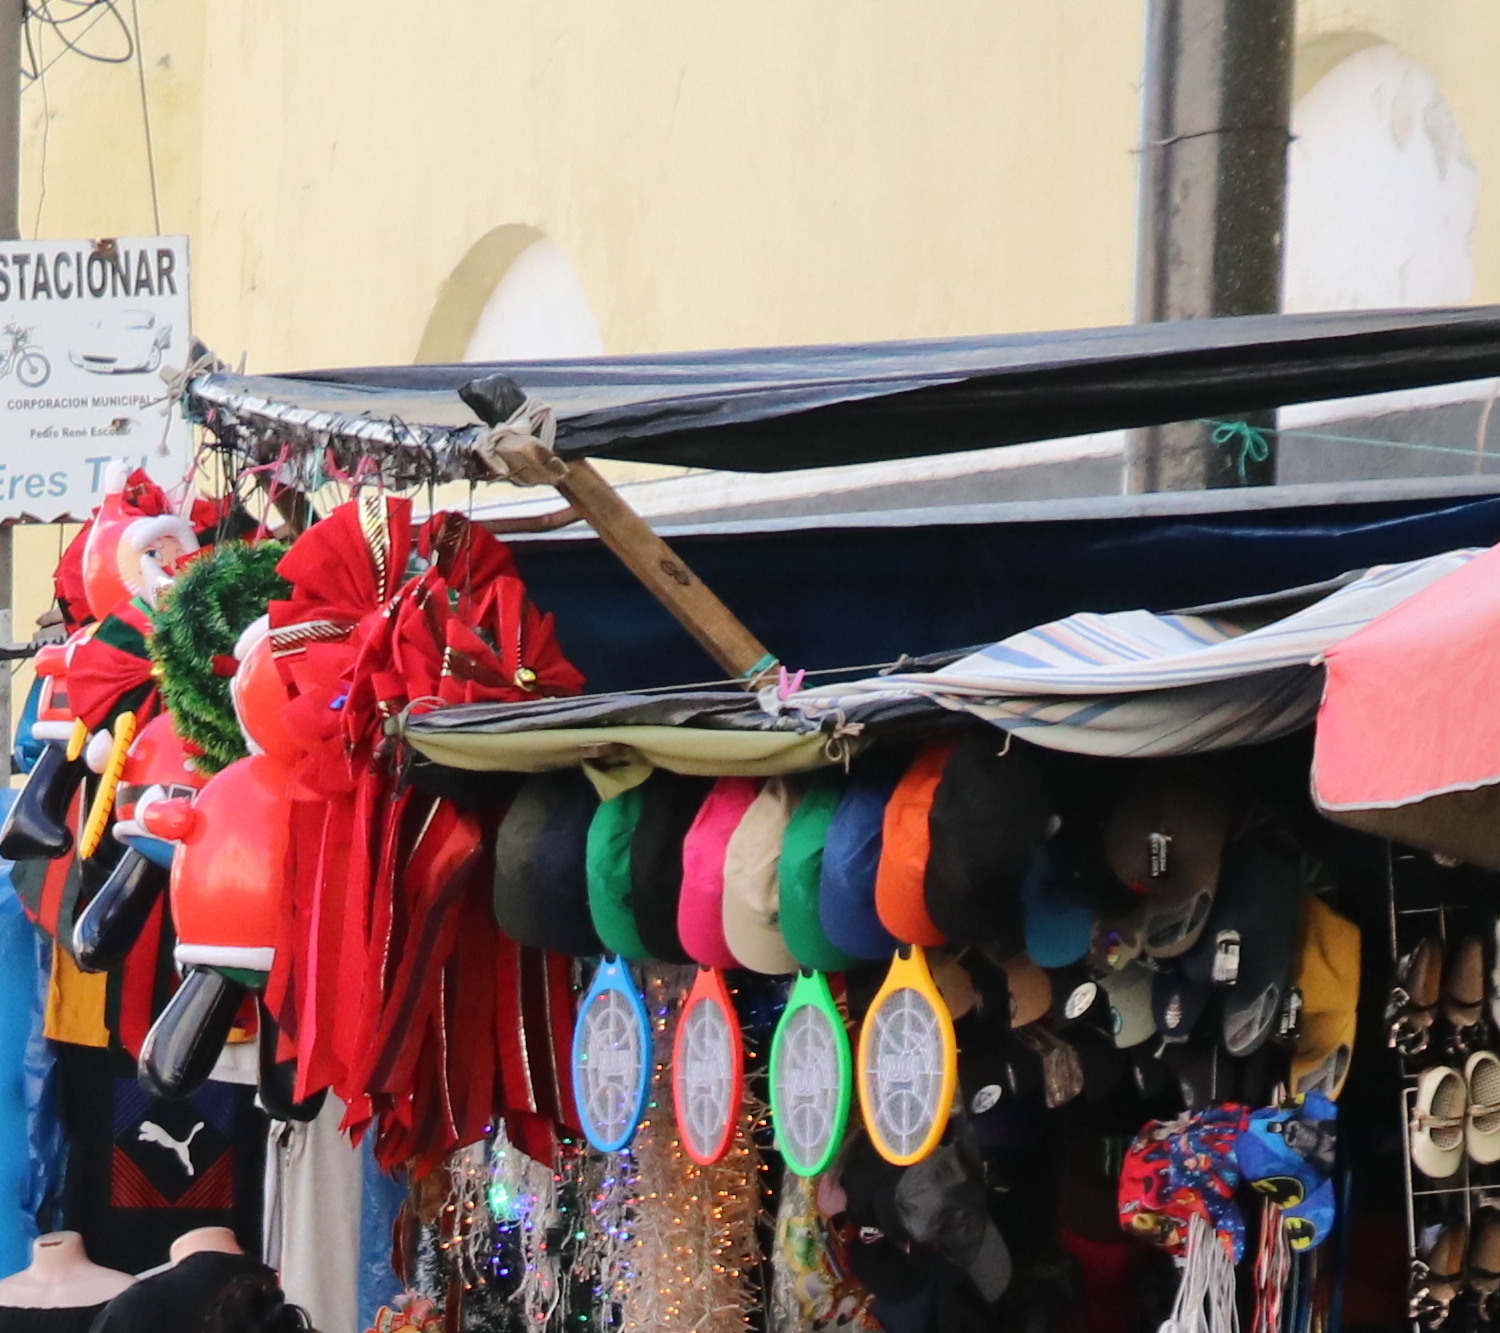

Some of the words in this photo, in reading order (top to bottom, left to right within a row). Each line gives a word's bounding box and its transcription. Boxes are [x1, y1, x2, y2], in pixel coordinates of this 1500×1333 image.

[6, 396, 88, 410] CORPORACION
[90, 394, 152, 408] MUNICIPAL
[30, 427, 60, 440] Pedro
[62, 425, 88, 438] René
[90, 425, 132, 438] Escobar
